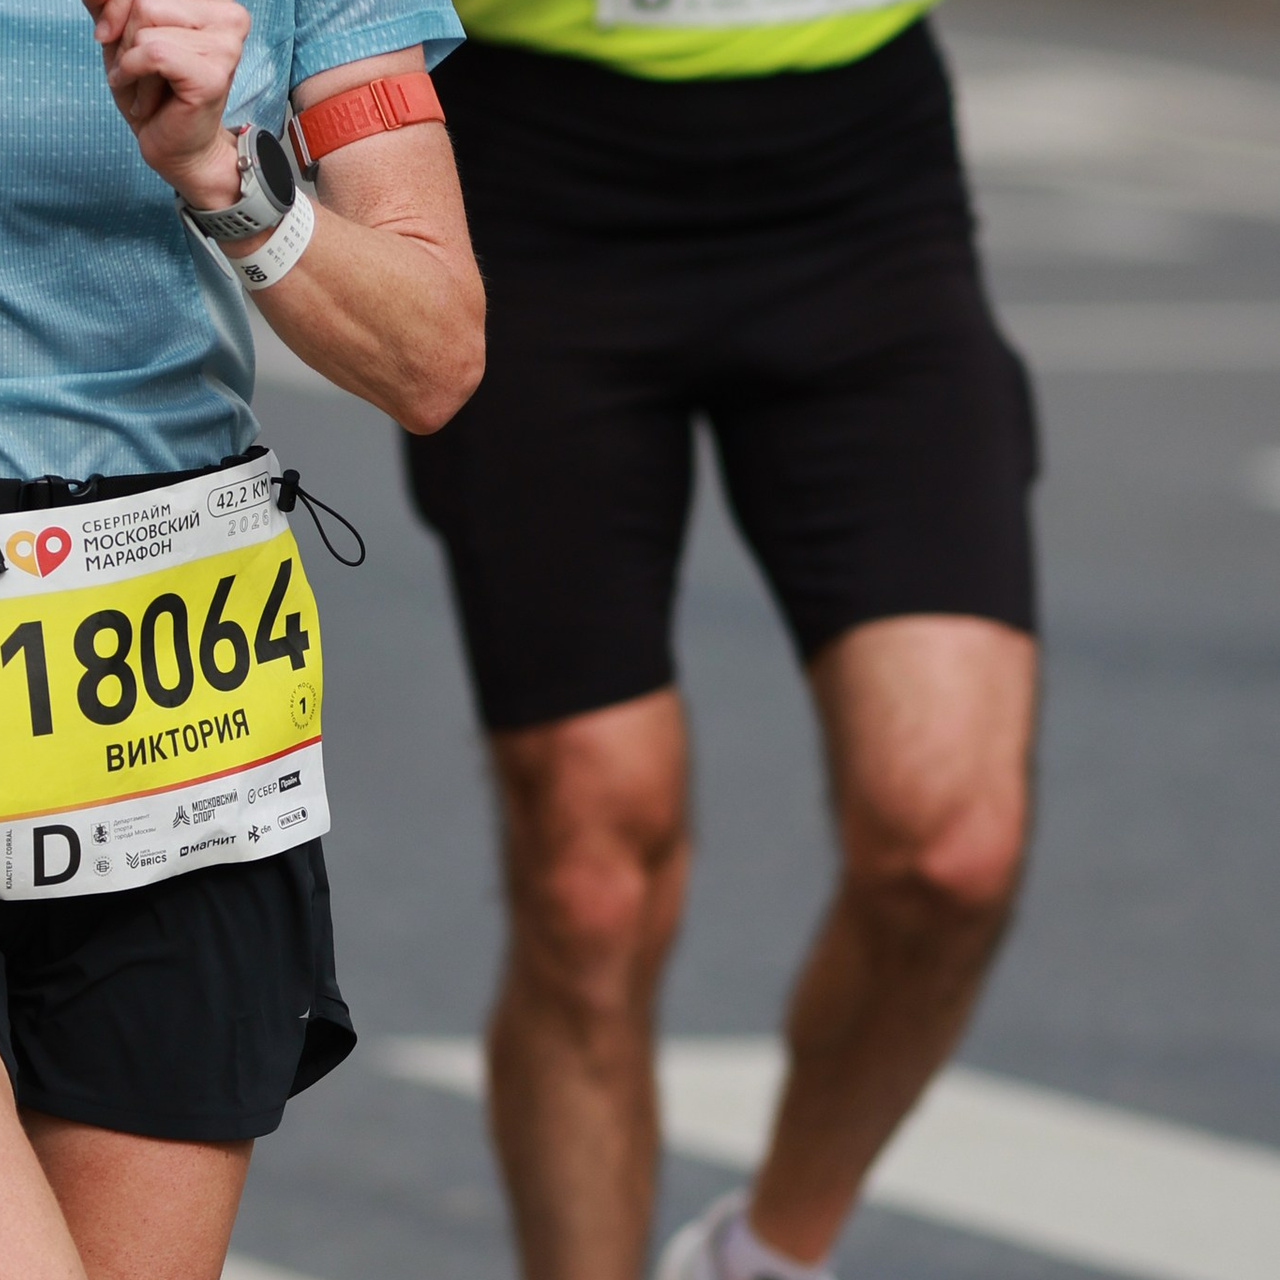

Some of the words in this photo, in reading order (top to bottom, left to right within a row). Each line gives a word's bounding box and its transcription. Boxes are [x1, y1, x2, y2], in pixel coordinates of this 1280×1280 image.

[216, 486, 247, 510] 42,2
[82, 503, 171, 533] СБЕРПРАЙМ
[84, 510, 200, 553] МОСКОВСКИЙ
[227, 508, 270, 537] 2026
[85, 538, 172, 571] МАРАФОН
[0, 557, 310, 738] 18064
[299, 696, 306, 715] 1
[106, 708, 250, 773] ВИКТОРИЯ
[191, 788, 239, 812] МОСКОВСКИЙ
[257, 782, 278, 798] СБЕР
[192, 809, 216, 824] СПОРТ
[33, 824, 81, 887] D
[140, 854, 167, 867] BRICS
